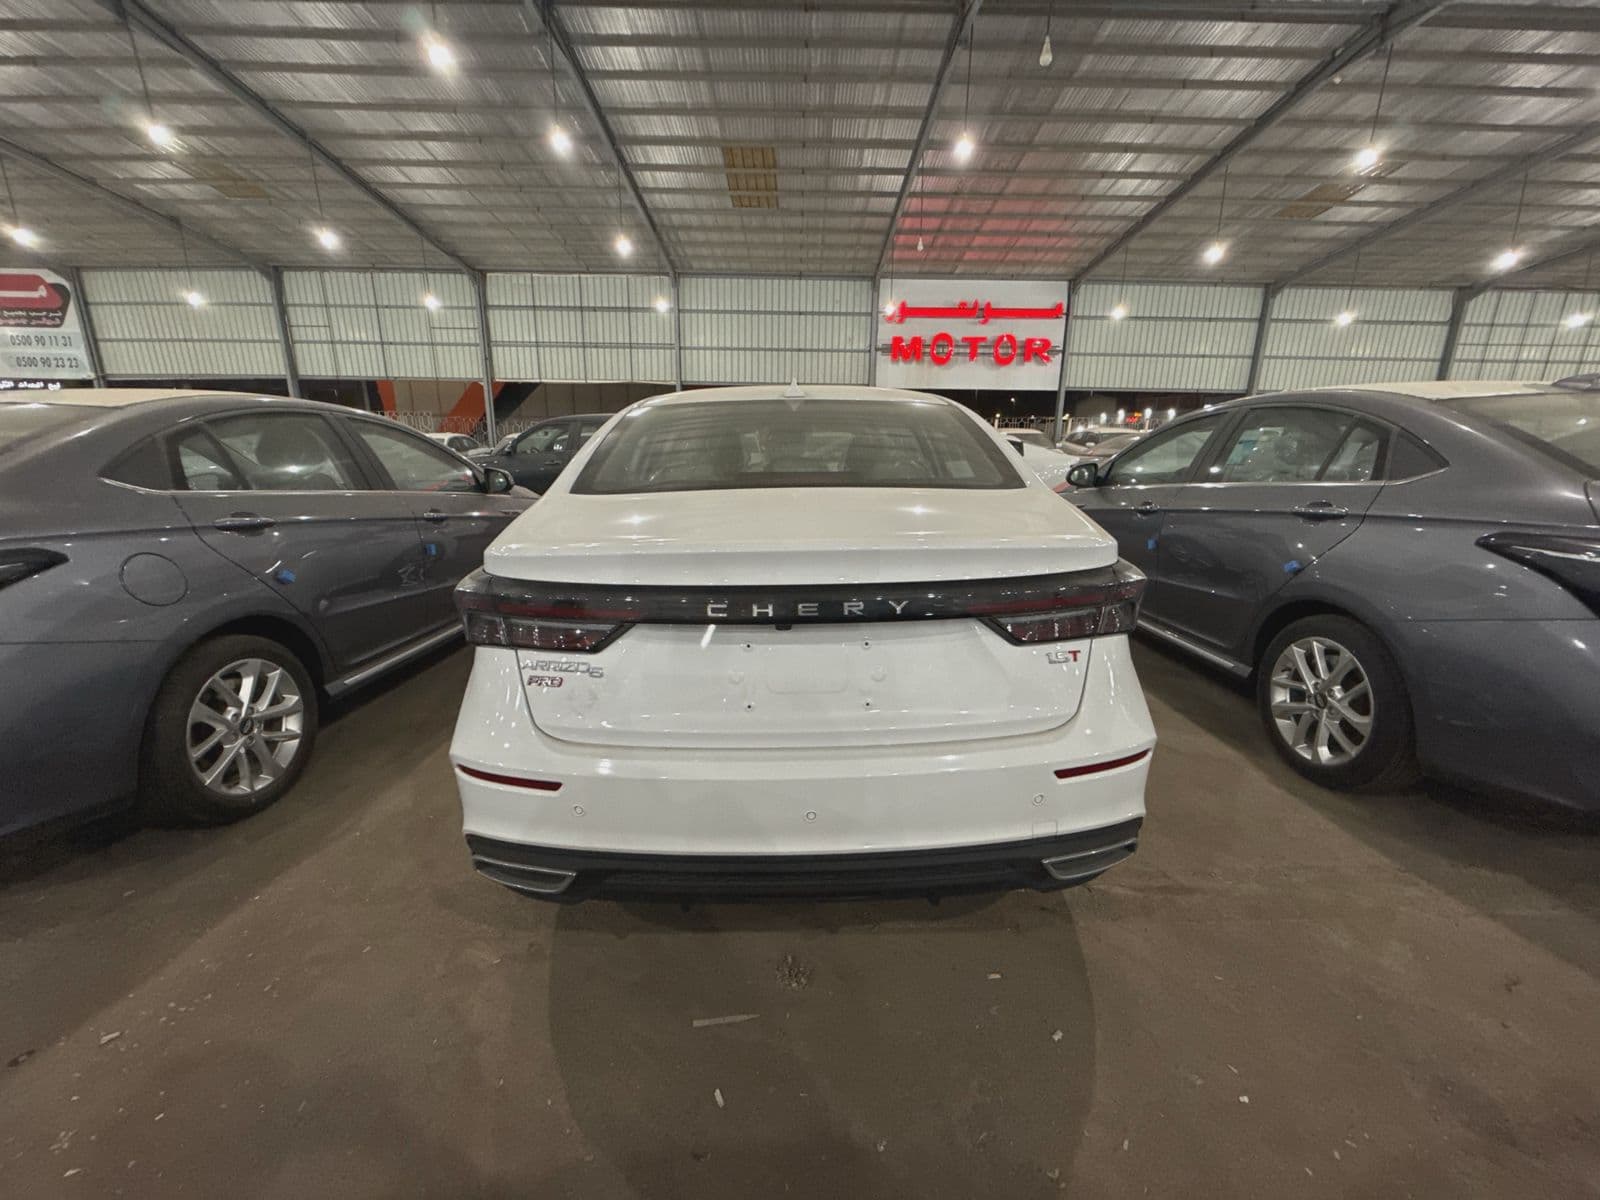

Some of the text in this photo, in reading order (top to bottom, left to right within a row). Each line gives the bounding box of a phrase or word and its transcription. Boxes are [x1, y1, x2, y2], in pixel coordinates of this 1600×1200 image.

[10, 335, 32, 346] 0500
[34, 335, 46, 346] 90
[890, 332, 1052, 366] MOTOR
[16, 356, 38, 368] 0500
[40, 357, 52, 368] 90
[706, 600, 909, 617] CHERY
[527, 675, 564, 688] PRO
